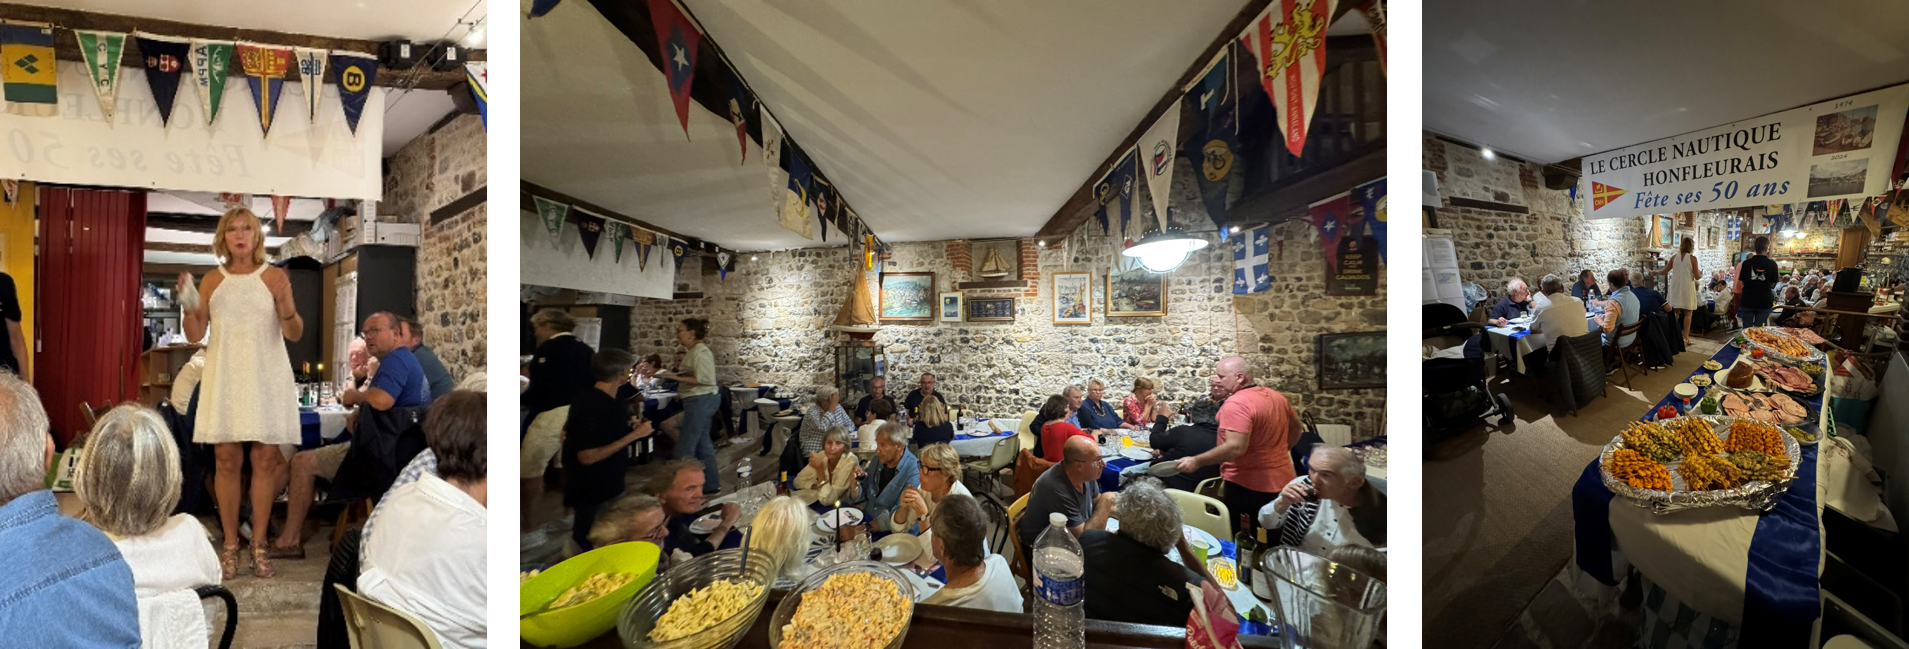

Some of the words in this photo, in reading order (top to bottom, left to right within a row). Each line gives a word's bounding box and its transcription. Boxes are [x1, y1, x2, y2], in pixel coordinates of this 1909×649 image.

[347, 72, 361, 86] B
[1834, 100, 1853, 109] 1974
[1590, 160, 1606, 175] LE
[1608, 146, 1668, 172] CERCLE
[1672, 122, 1782, 160] NAUTIQUE
[1643, 151, 1779, 187] HONFLEURAIS
[1633, 190, 1670, 209] Fête
[1675, 189, 1702, 205] ses
[1709, 180, 1739, 203] 50
[1746, 179, 1791, 198] ans
